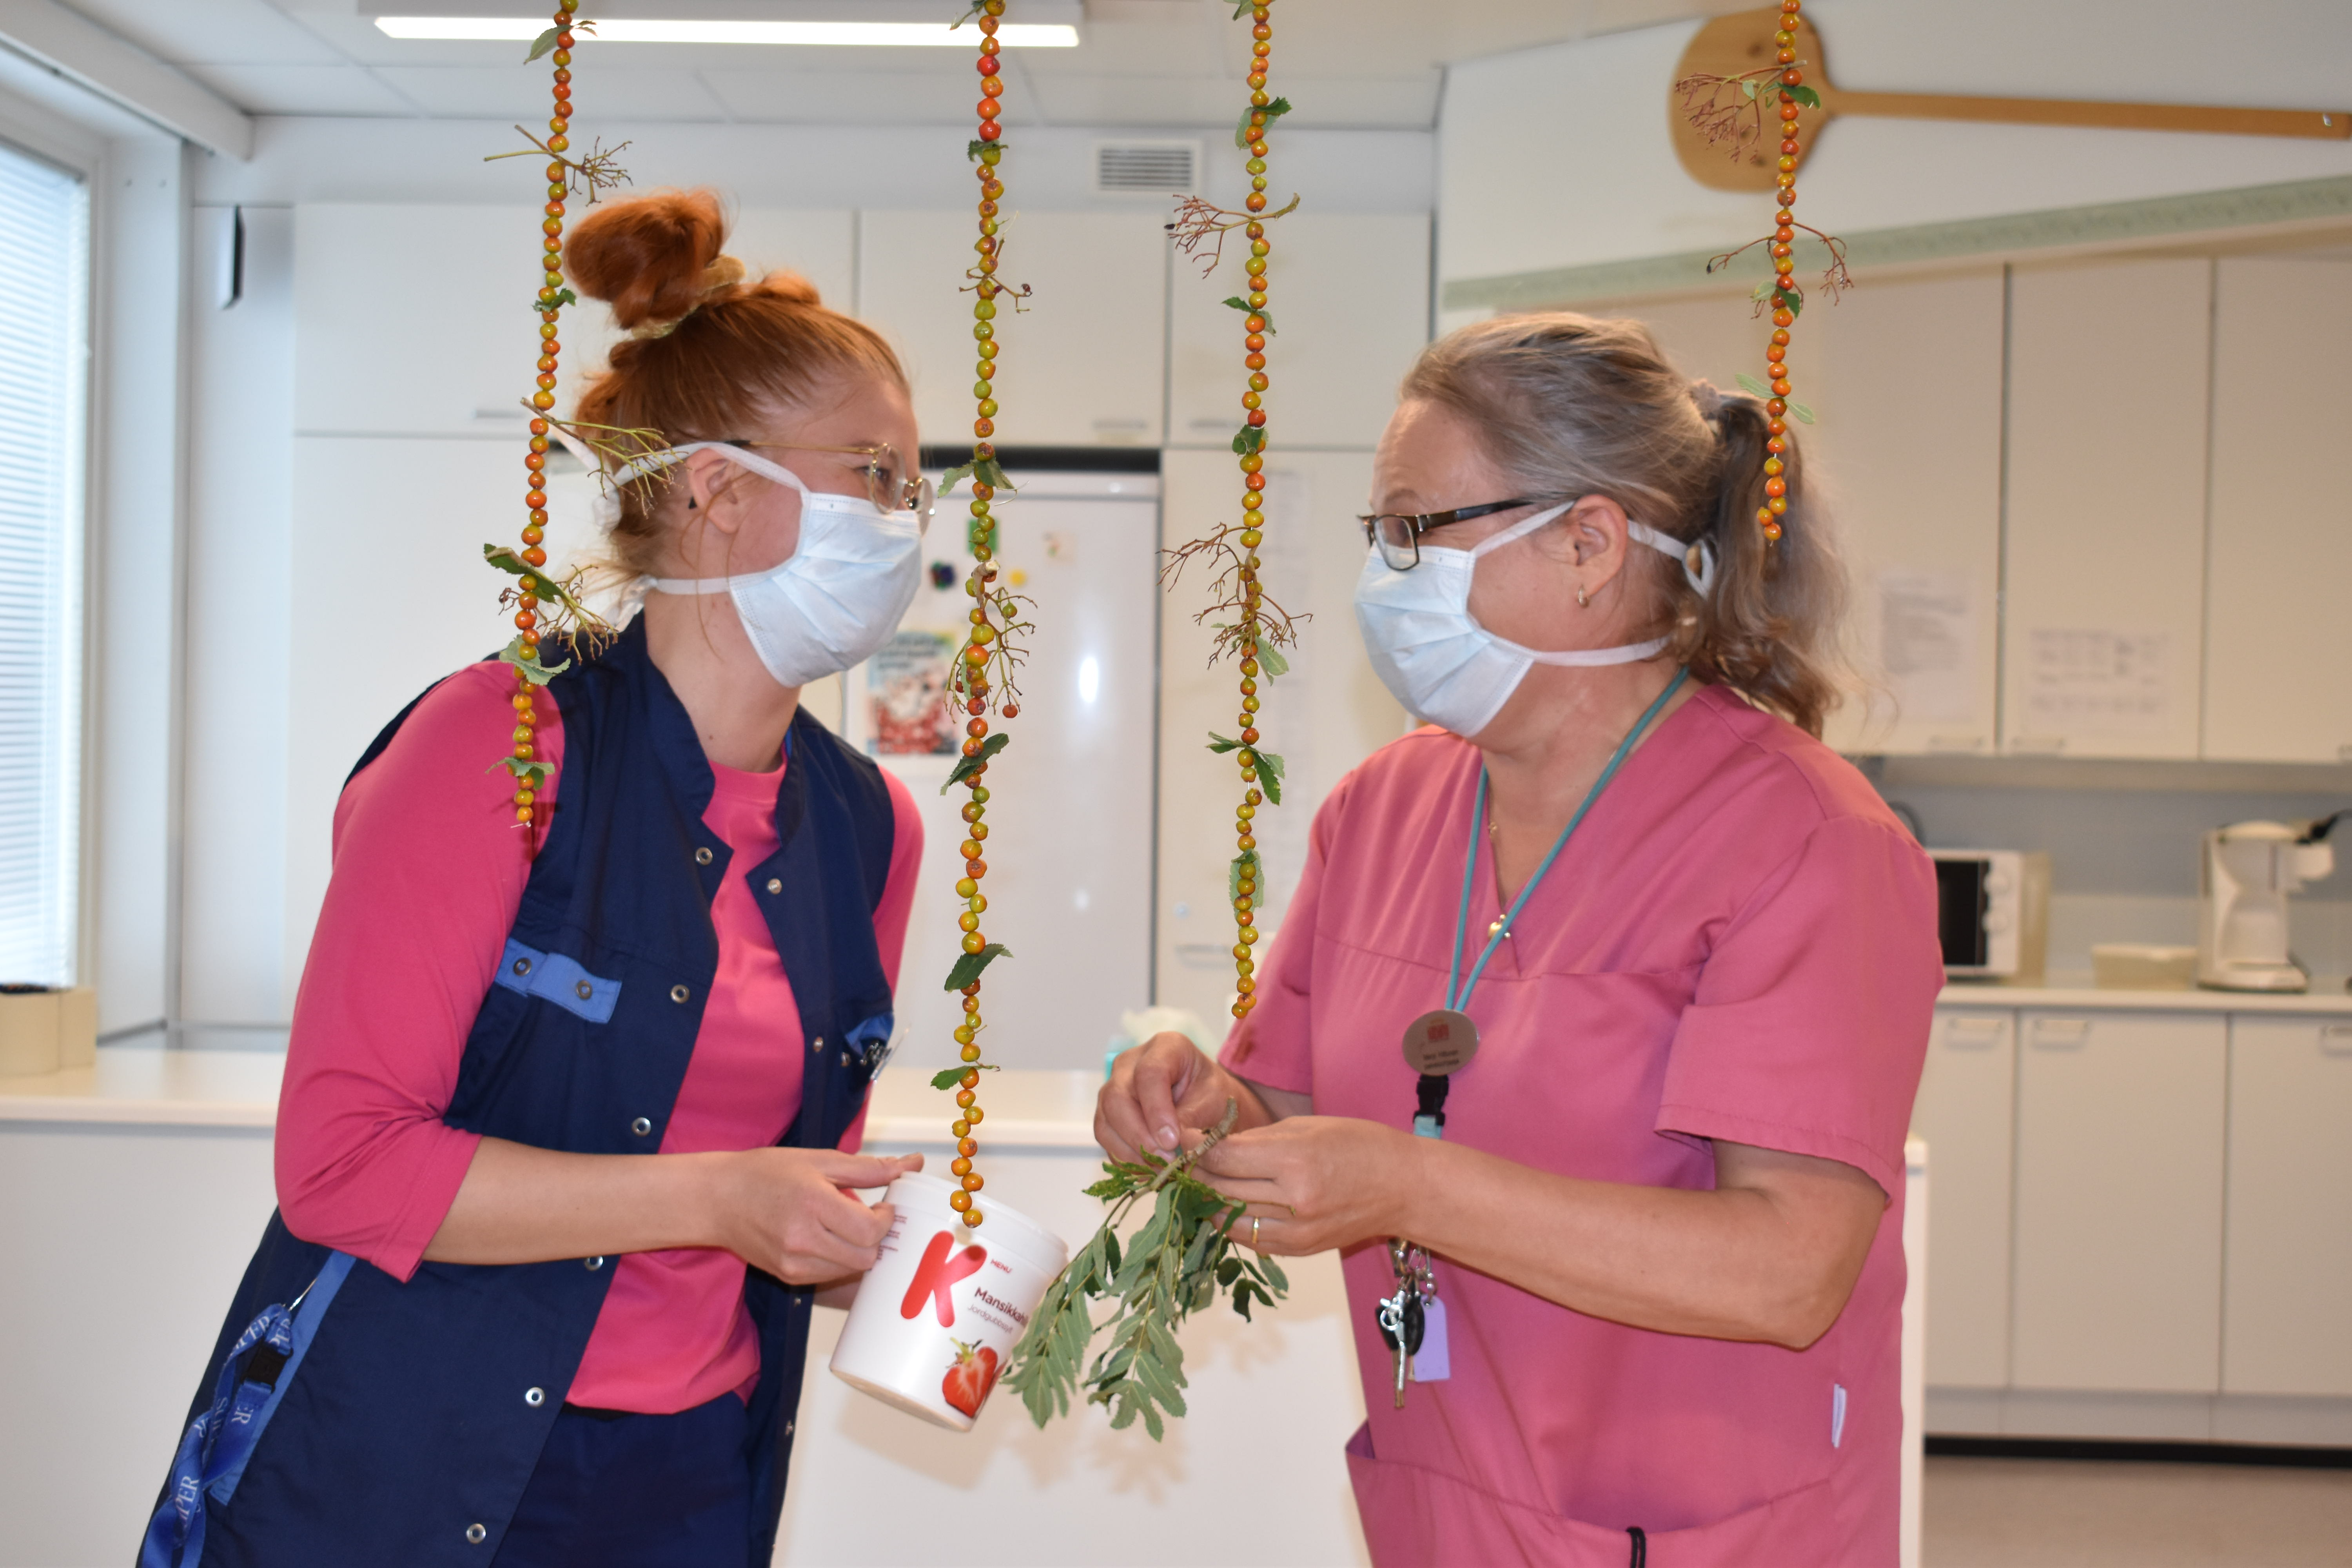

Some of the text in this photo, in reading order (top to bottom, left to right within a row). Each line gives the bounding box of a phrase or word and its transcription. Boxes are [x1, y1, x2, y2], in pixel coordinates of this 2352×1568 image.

[900, 1230, 987, 1327] K
[990, 1259, 1012, 1274] MENU
[175, 1476, 199, 1520] PER
